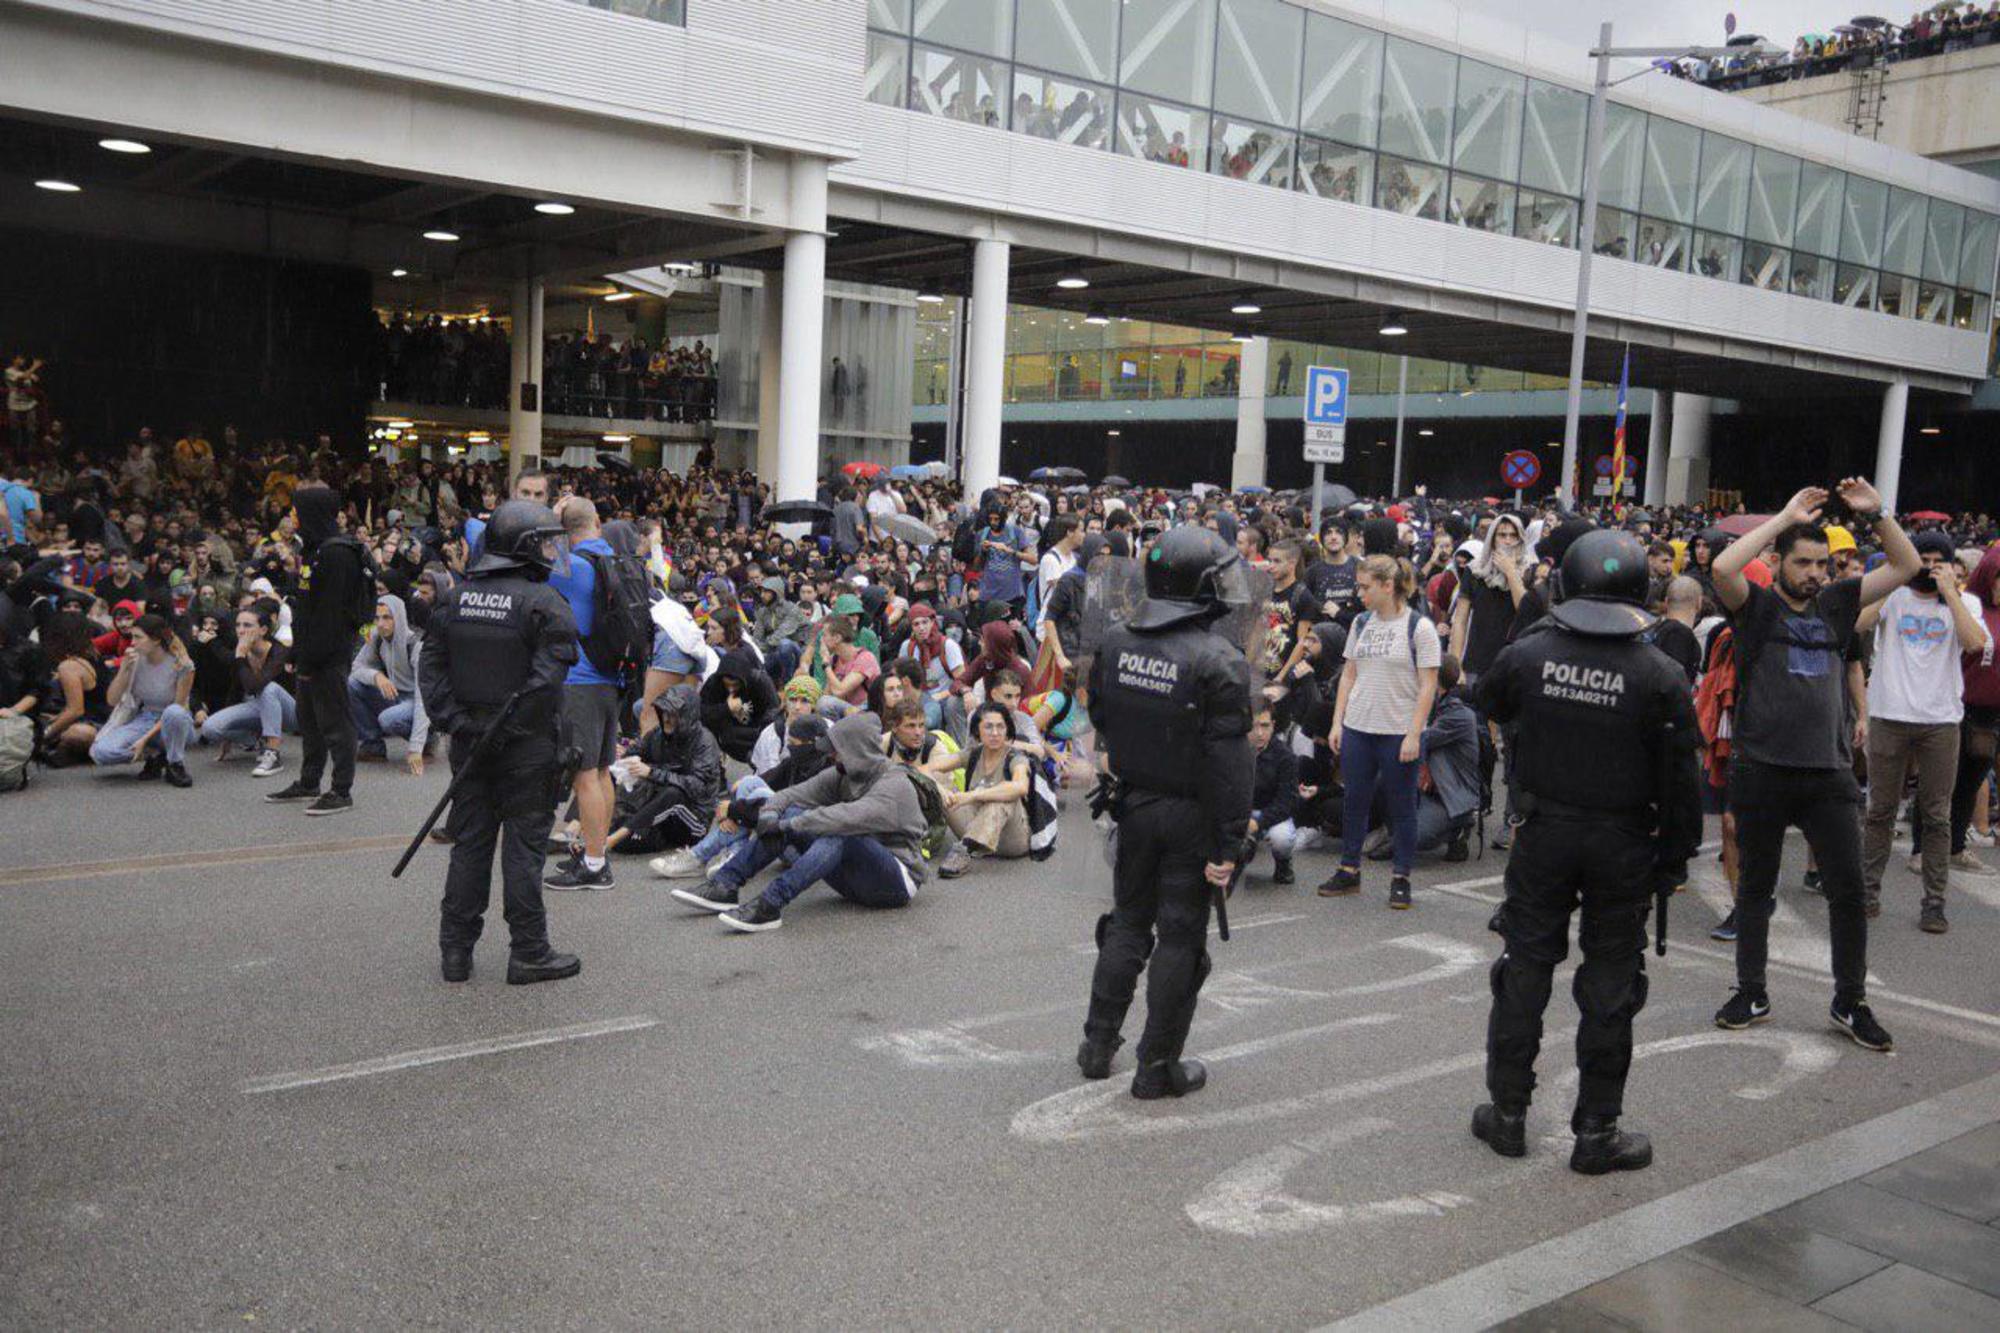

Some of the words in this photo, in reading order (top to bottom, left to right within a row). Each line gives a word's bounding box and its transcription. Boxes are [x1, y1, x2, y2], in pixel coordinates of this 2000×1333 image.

[1315, 374, 1340, 417] P
[1316, 429, 1334, 439] BUS
[459, 592, 512, 609] POLICIA
[1118, 652, 1178, 682] POLICIA
[1542, 661, 1625, 693] POLICIA
[1543, 684, 1617, 707] D513A0211
